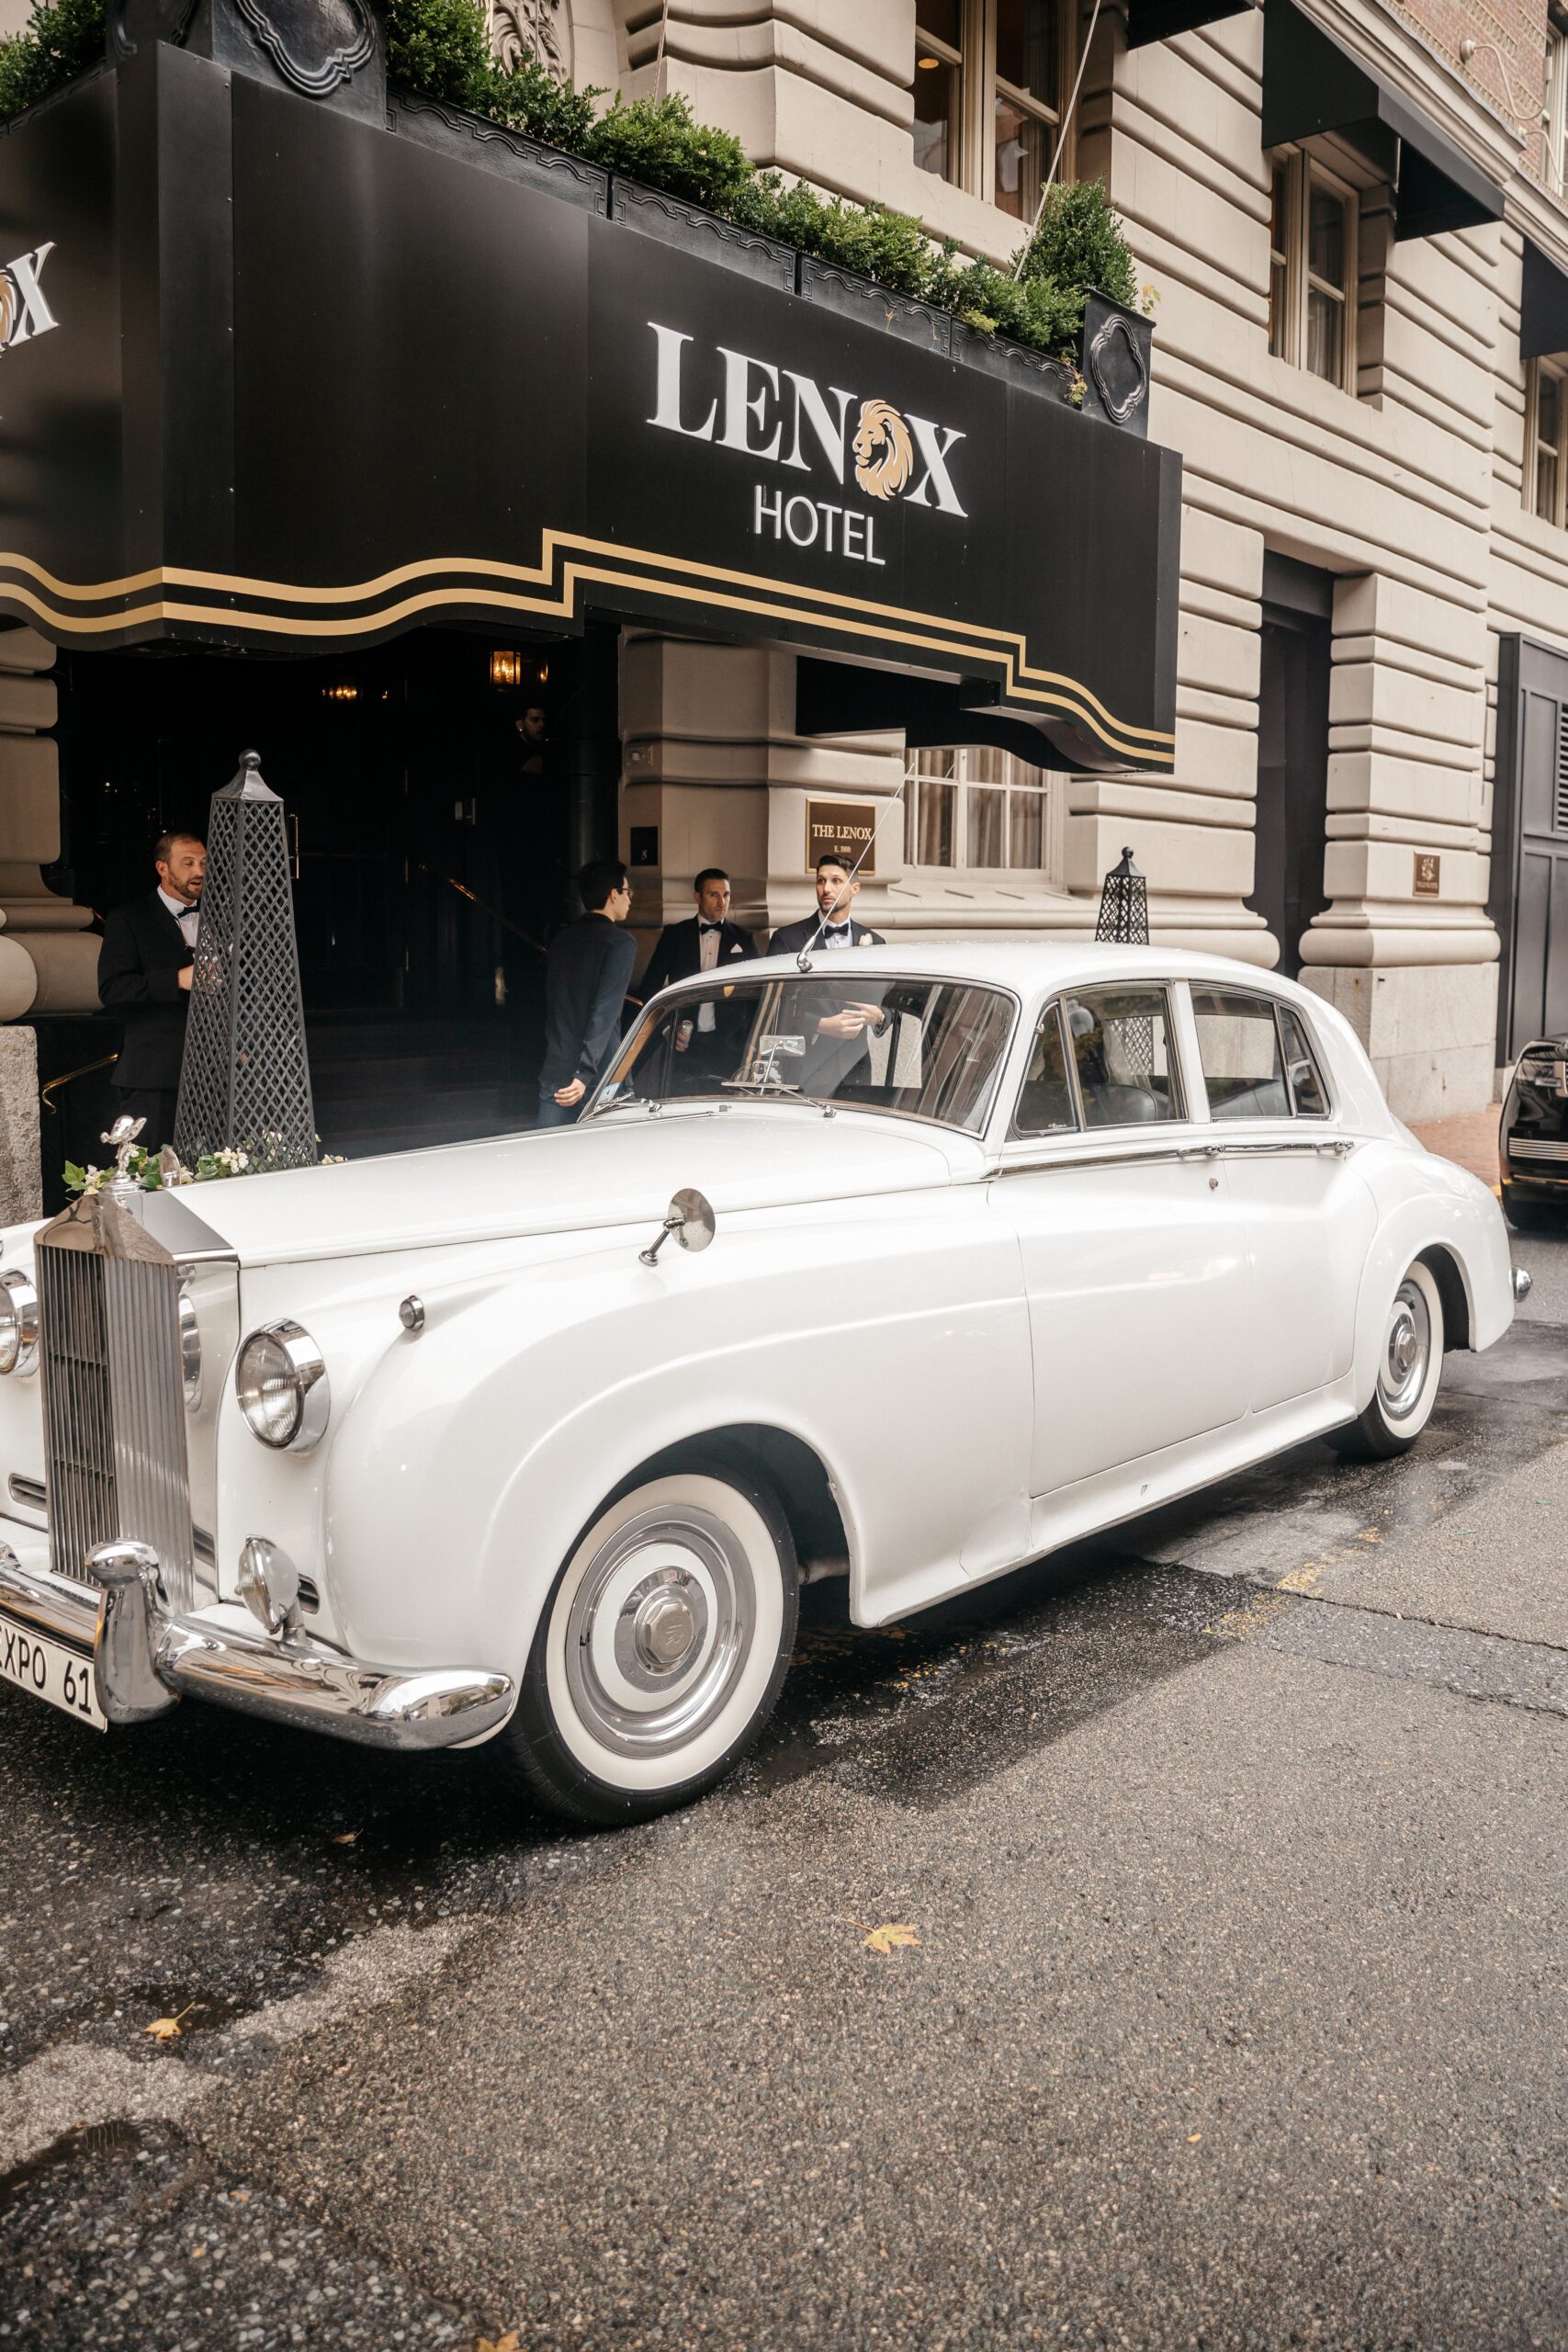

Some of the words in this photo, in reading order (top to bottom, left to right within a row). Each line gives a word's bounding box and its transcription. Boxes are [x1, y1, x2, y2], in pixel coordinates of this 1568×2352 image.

[752, 484, 886, 566] HOTEL
[812, 824, 835, 838] THE
[836, 825, 873, 841] LENOX
[0, 1624, 47, 1690] XPO
[63, 1659, 93, 1716] 61
